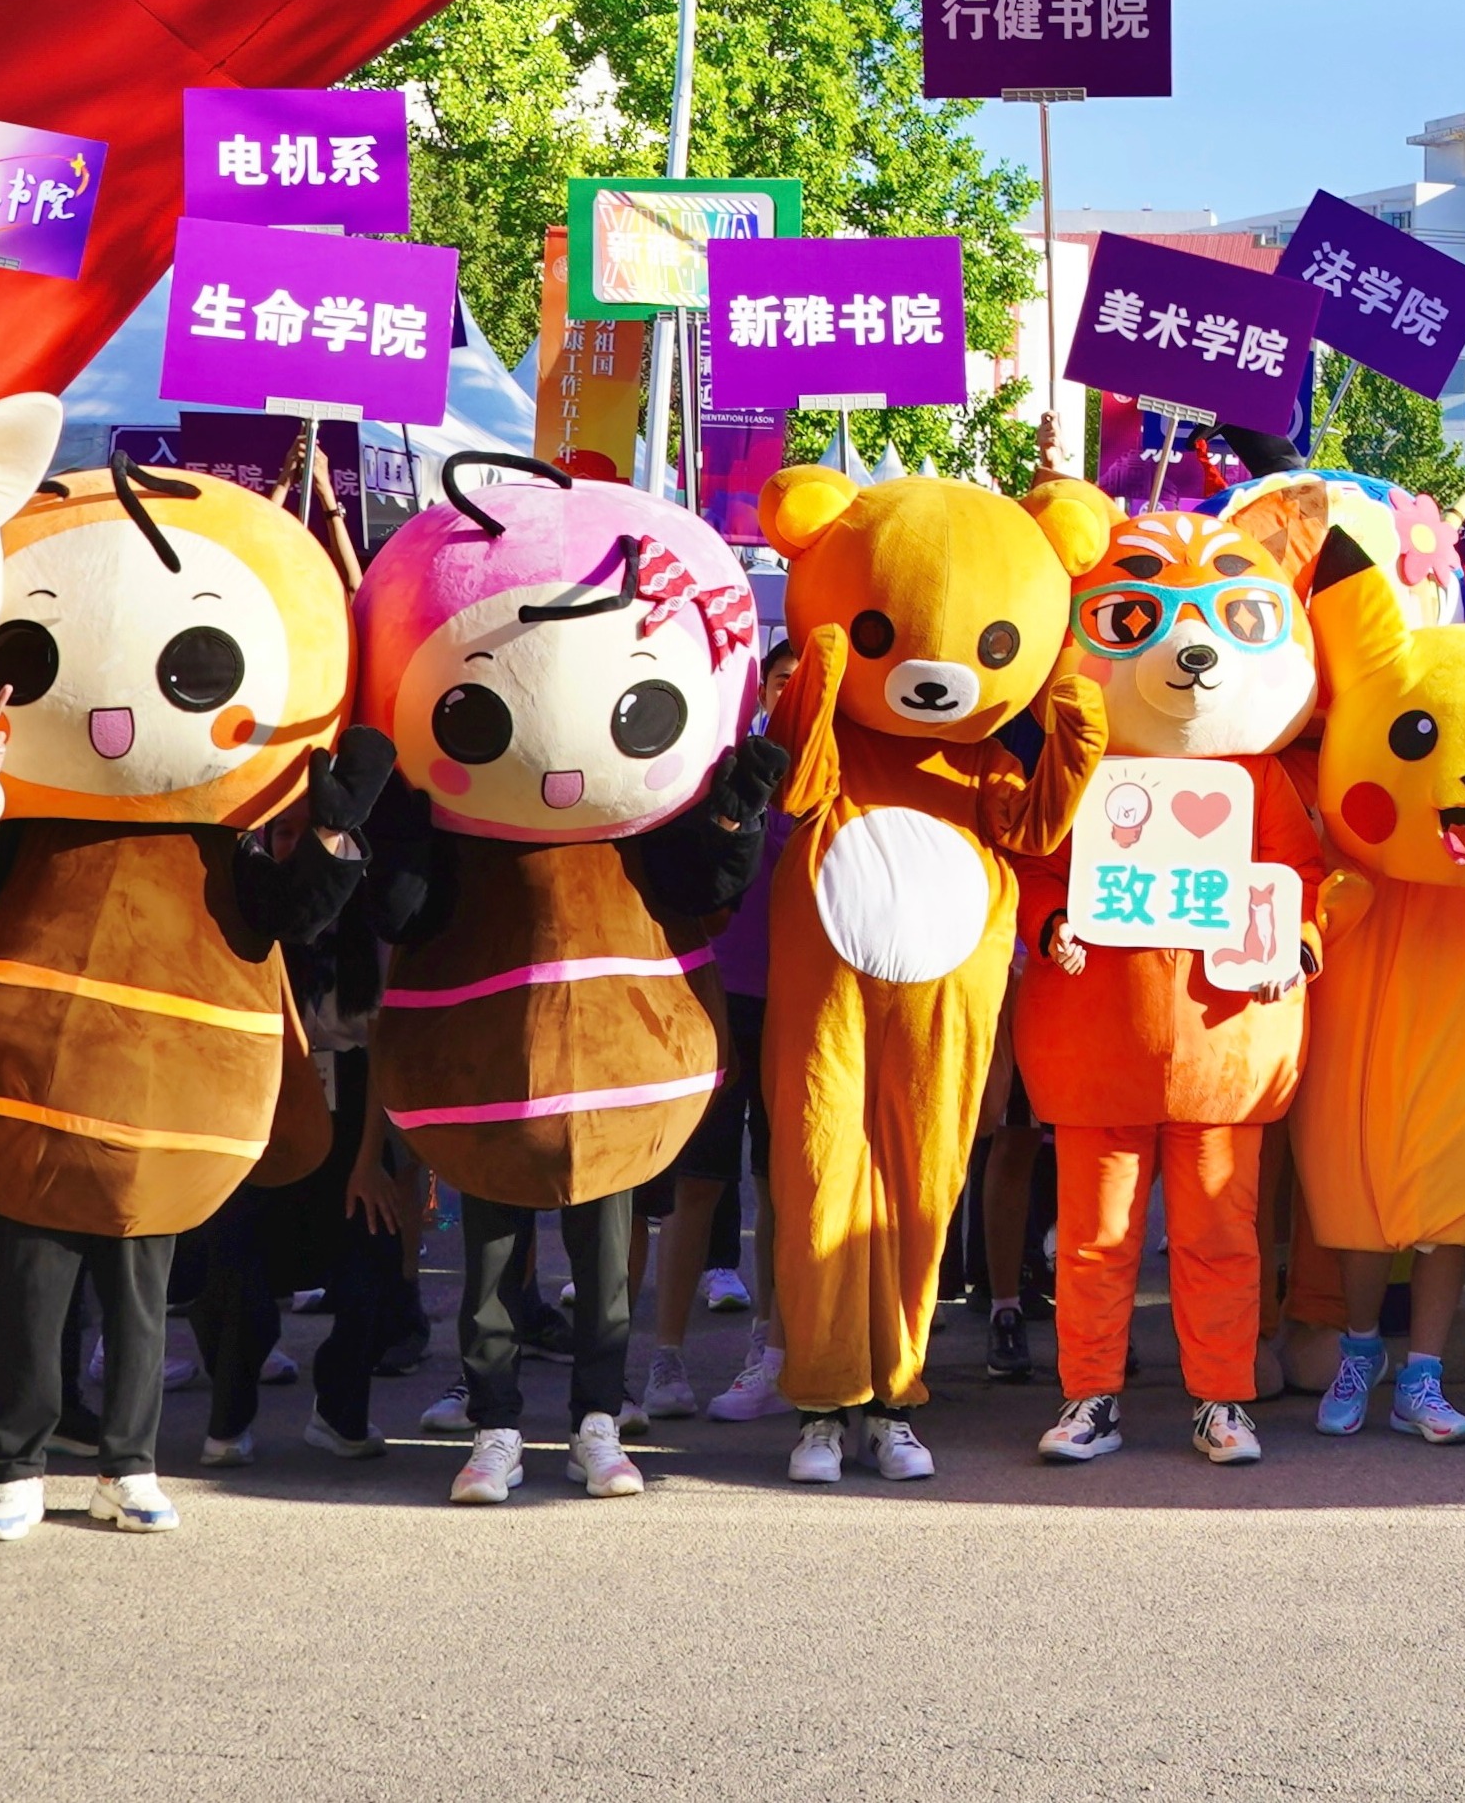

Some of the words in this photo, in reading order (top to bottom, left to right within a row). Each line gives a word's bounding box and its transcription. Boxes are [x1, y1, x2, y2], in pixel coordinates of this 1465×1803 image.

[218, 133, 380, 186] 电机系
[190, 283, 427, 360] 生命学院
[728, 292, 944, 348] 新雅书院
[1301, 241, 1450, 348] 法学院
[1093, 288, 1288, 378] 美术学院
[701, 414, 744, 423] RIENTATION
[1092, 864, 1231, 929] 致理
